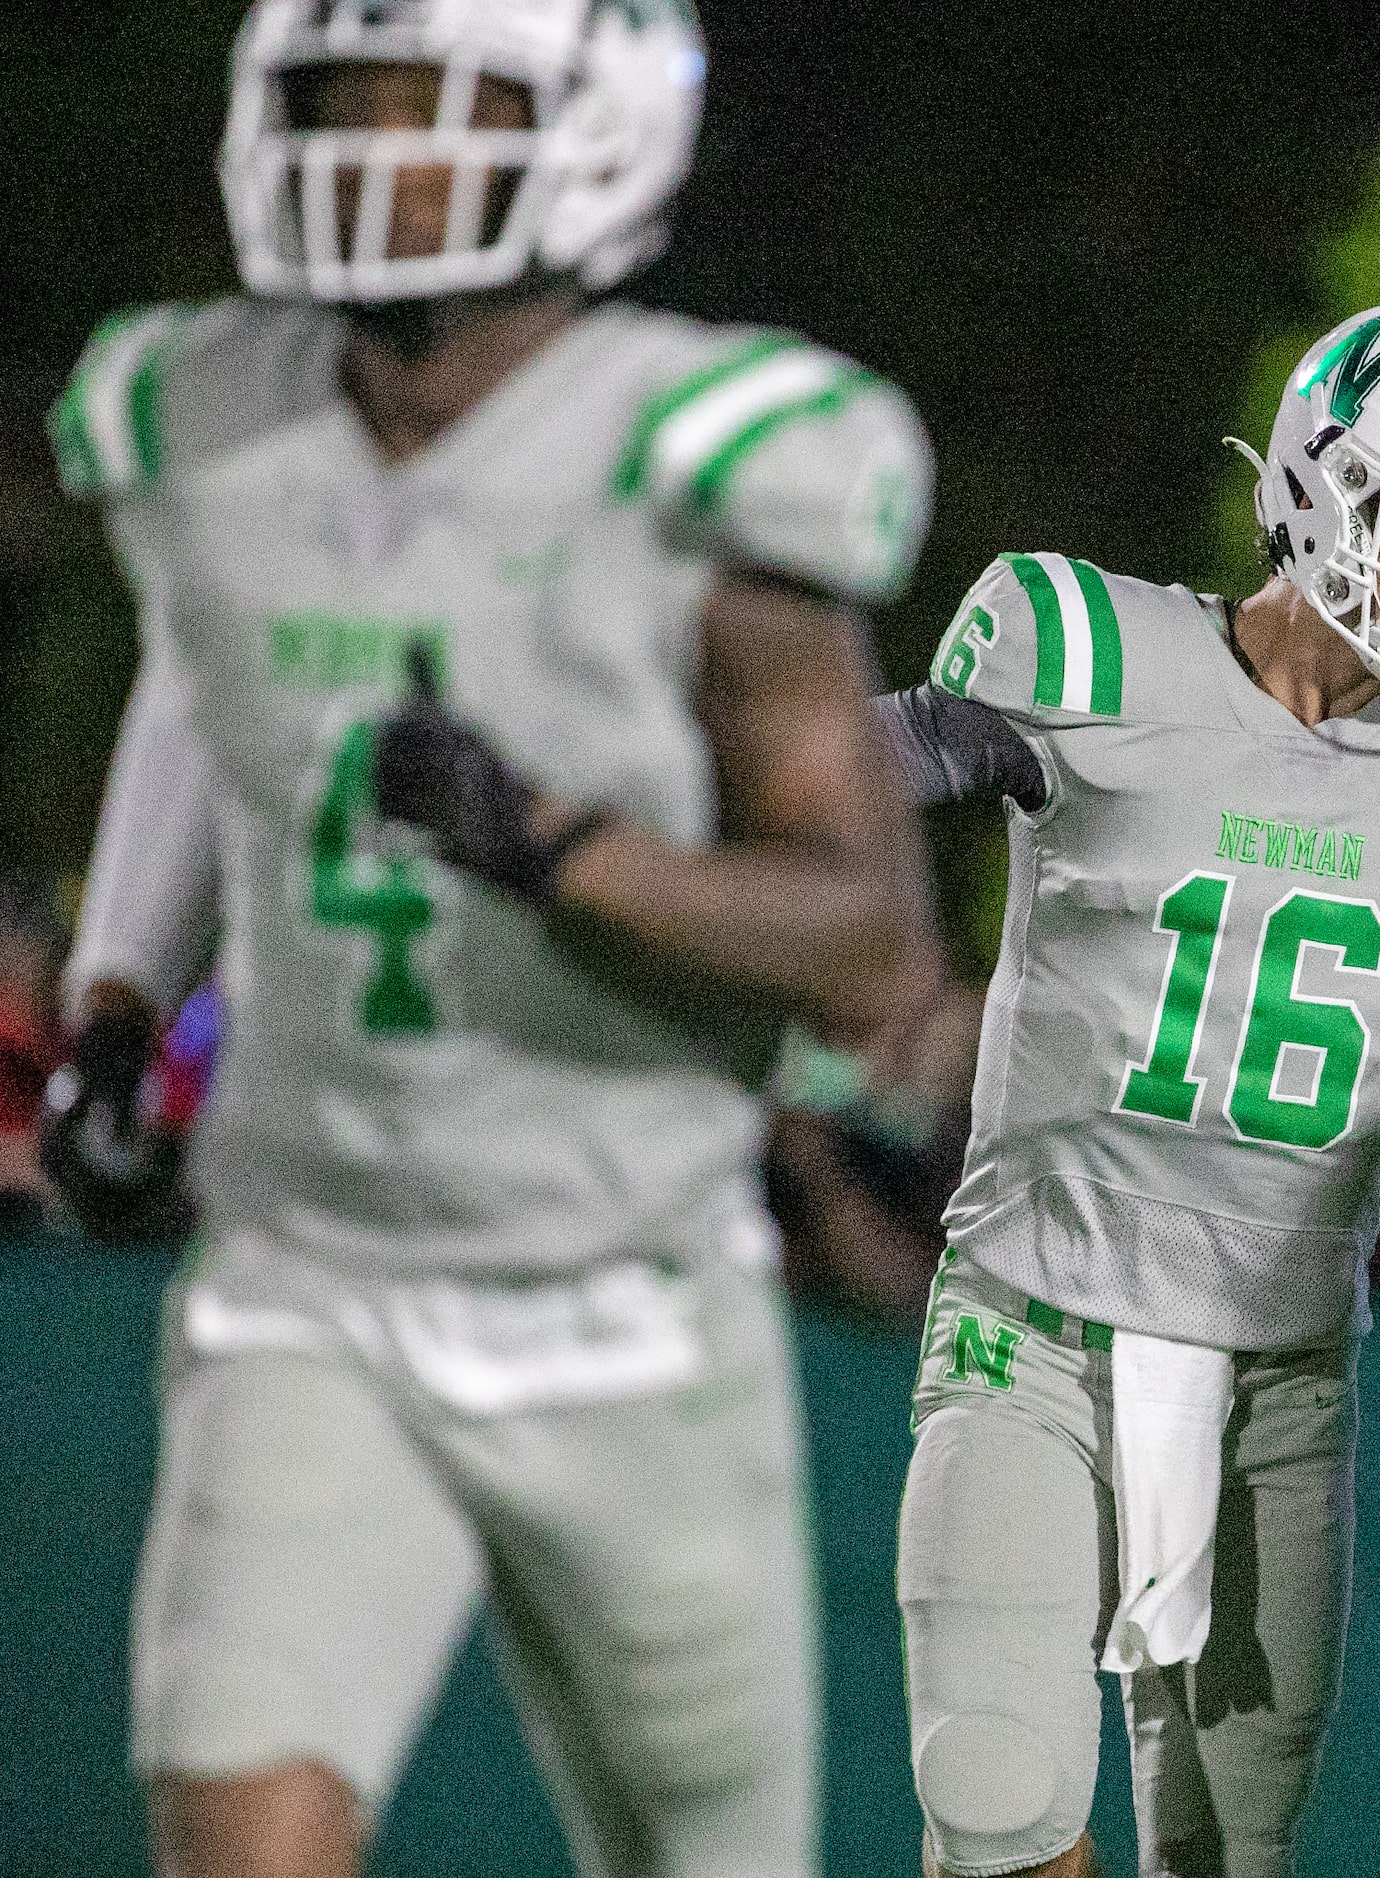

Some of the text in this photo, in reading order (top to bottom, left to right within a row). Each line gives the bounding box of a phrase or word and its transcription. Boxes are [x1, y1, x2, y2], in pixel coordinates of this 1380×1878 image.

[932, 597, 1000, 698] 6
[308, 715, 438, 1036] 4
[1215, 811, 1366, 881] NEWMAN
[943, 1313, 1026, 1393] N
